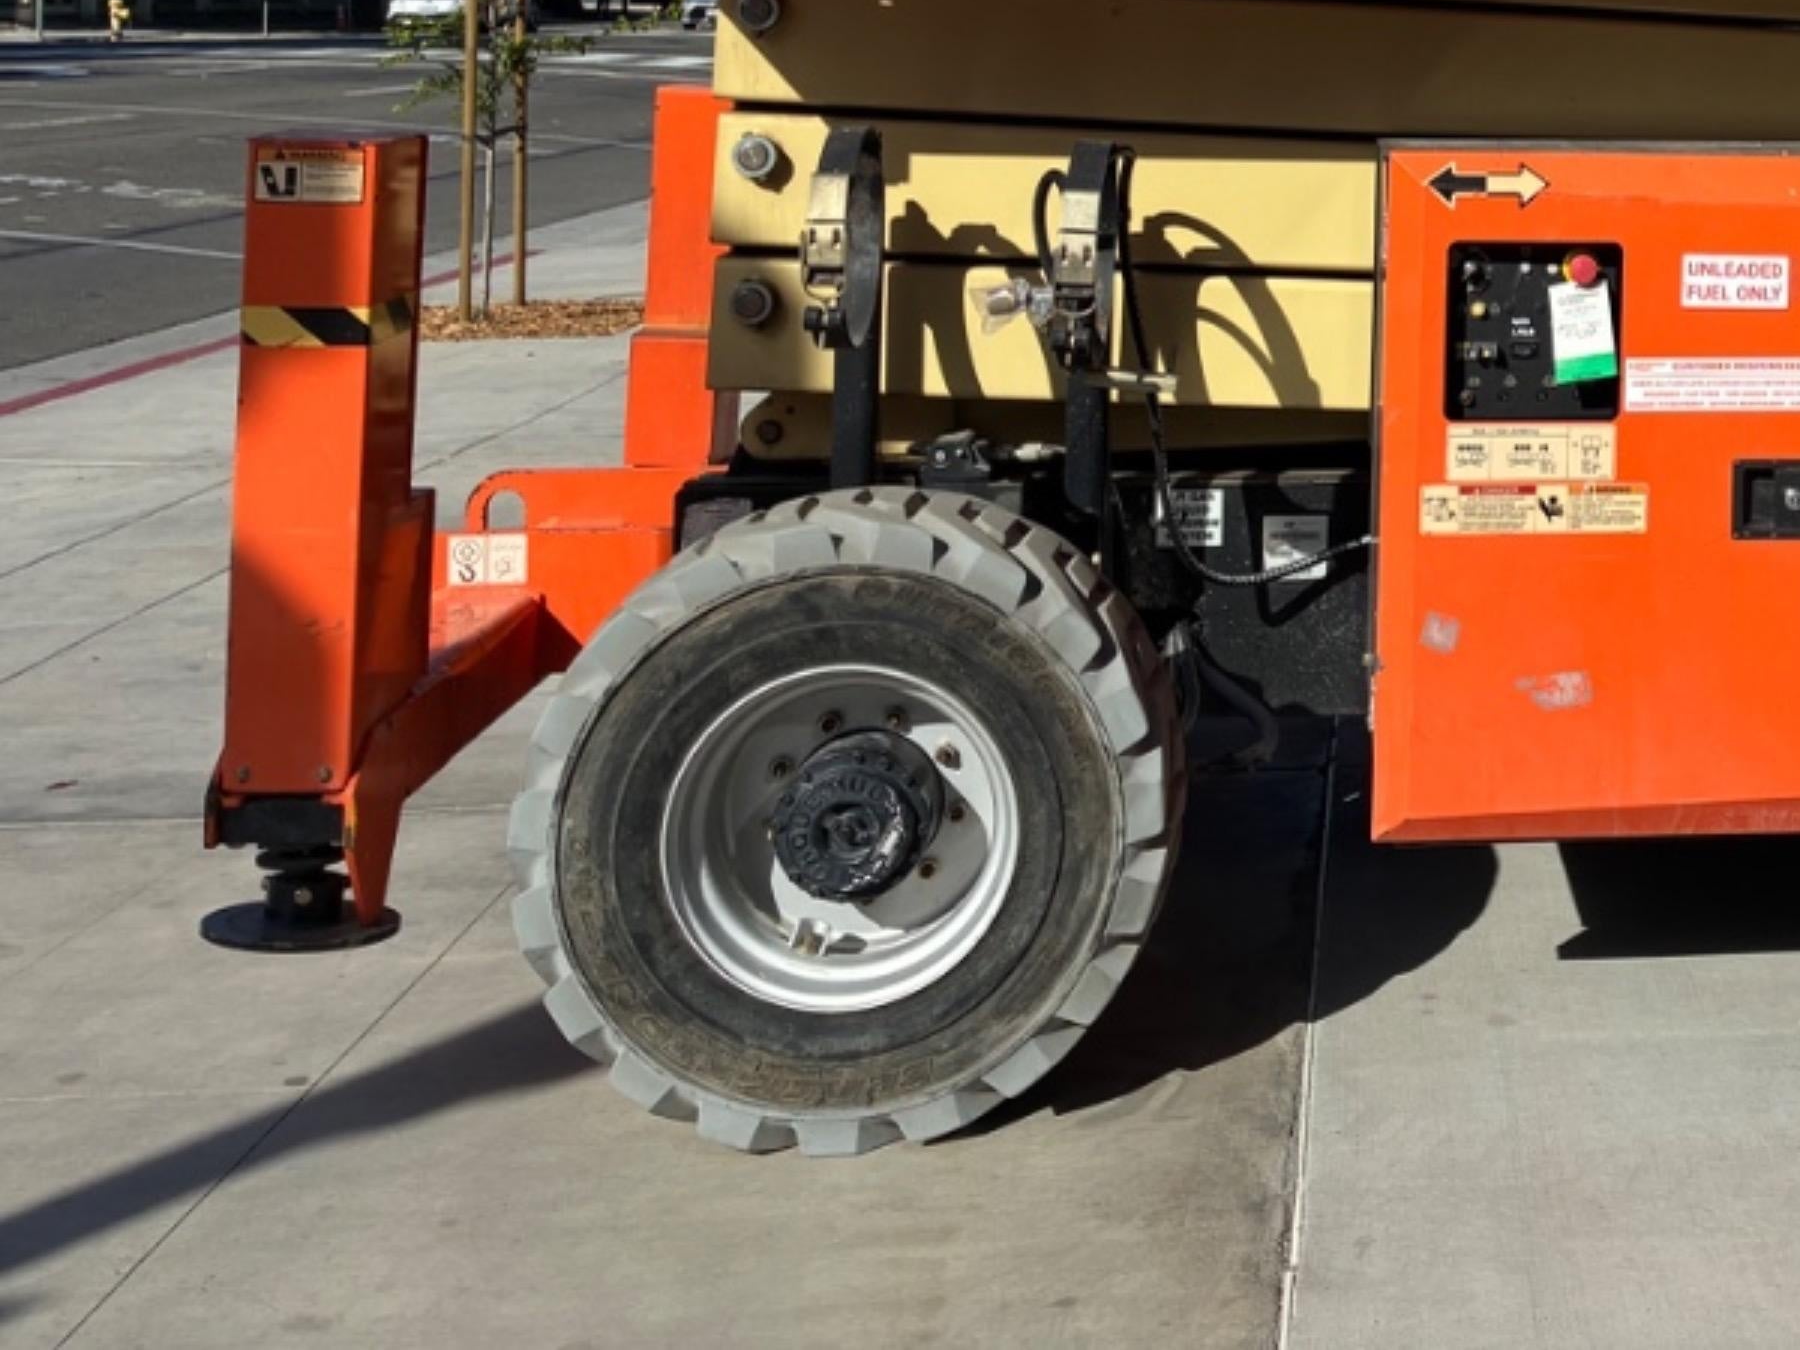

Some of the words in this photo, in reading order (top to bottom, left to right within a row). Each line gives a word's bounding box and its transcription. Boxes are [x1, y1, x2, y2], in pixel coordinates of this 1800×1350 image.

[1687, 260, 1783, 279] UNLEADED
[1686, 284, 1729, 302] FUEL
[1736, 283, 1783, 302] ONLY
